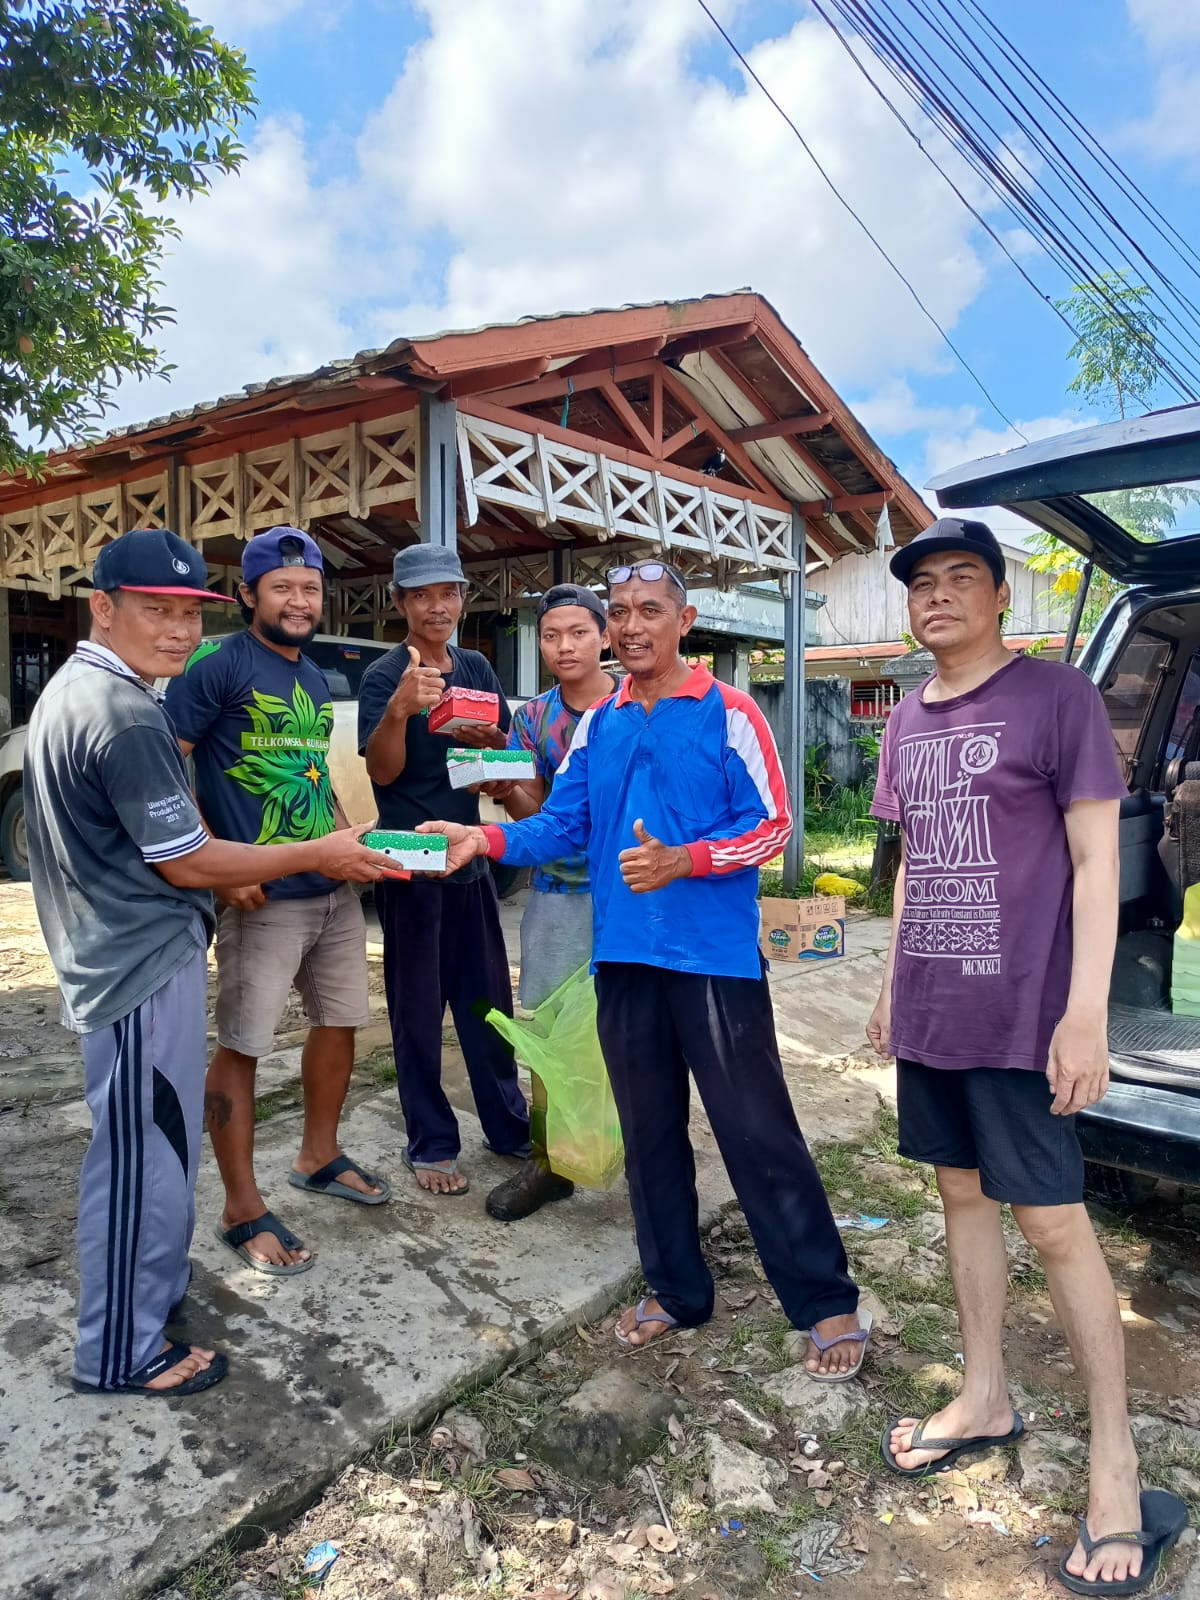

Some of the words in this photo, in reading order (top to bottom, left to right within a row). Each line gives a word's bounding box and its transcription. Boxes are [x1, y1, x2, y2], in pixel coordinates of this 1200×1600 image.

[251, 736, 304, 747] TELKOMSEL
[906, 877, 998, 903] OLCOM
[951, 908, 972, 919] Constant
[973, 909, 979, 919] is
[979, 908, 1001, 920] Change.
[962, 958, 1001, 976] MCMXCI
